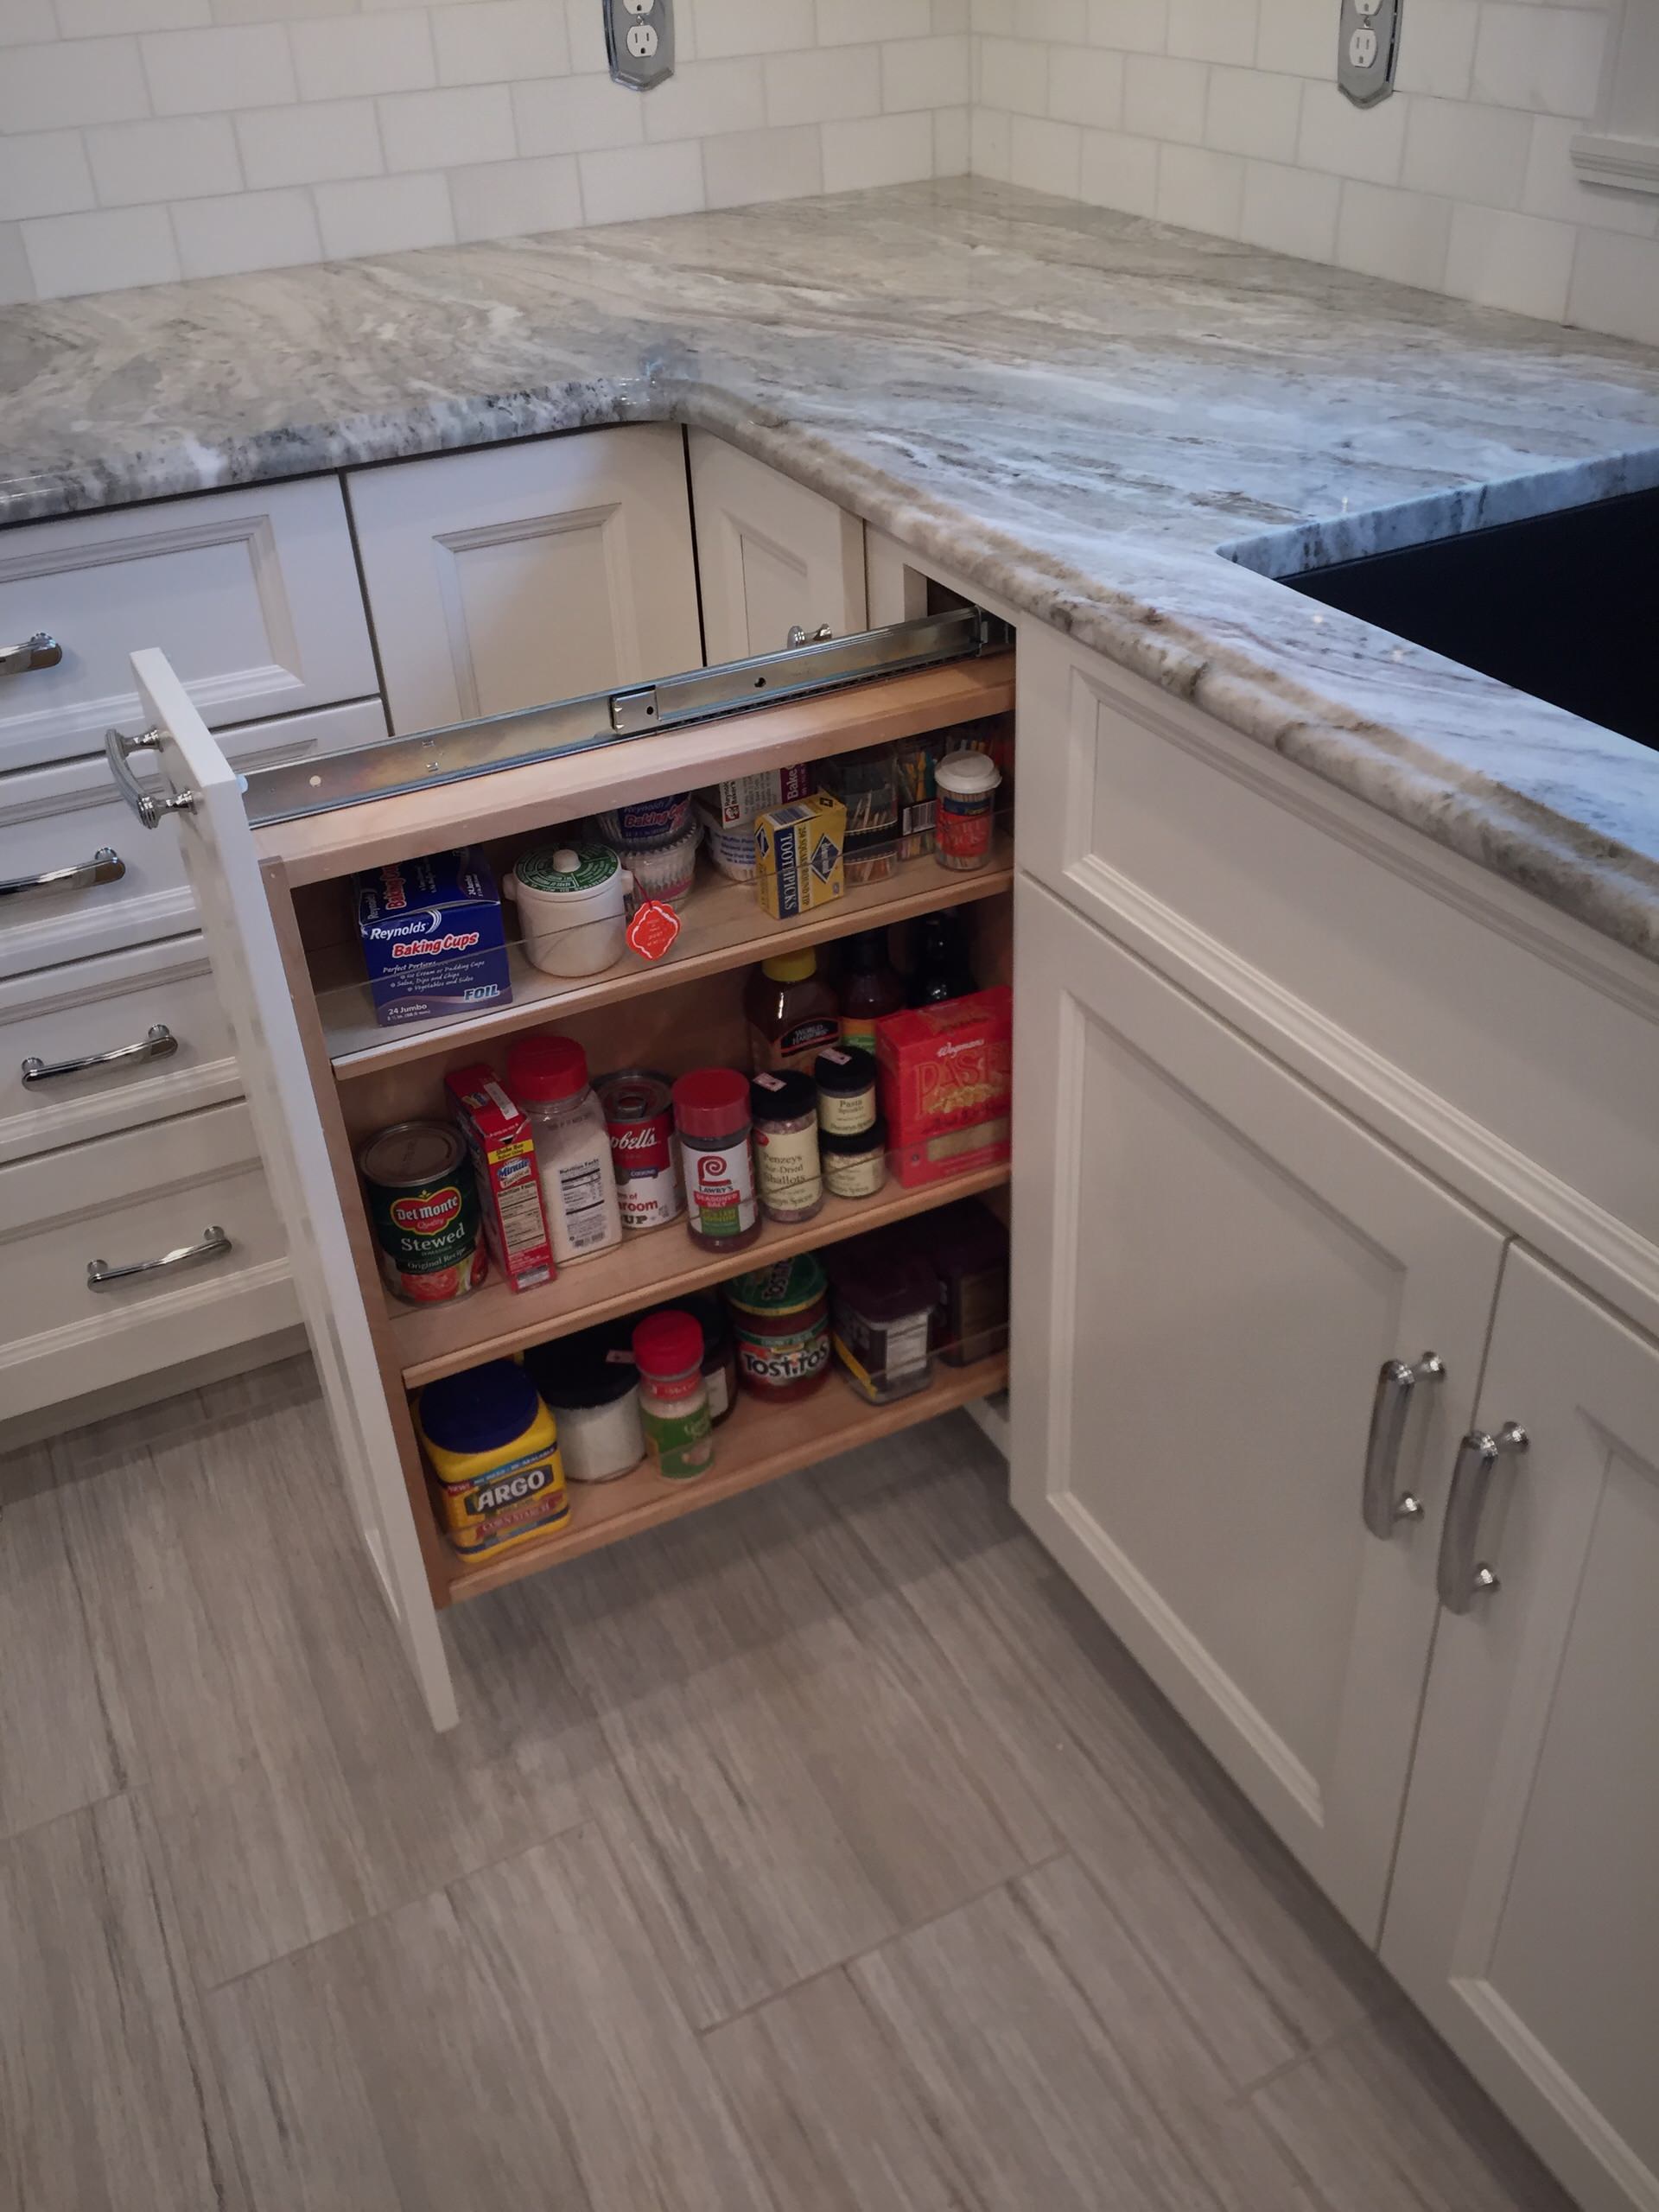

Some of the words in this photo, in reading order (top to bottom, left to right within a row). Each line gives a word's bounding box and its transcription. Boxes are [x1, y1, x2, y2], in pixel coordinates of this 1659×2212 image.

[625, 810, 670, 828] Baking
[779, 832, 796, 910] TOOTHPICKS
[385, 878, 407, 909] Baking
[370, 921, 427, 941] Reynolds
[392, 938, 442, 958] Baking
[442, 931, 480, 950] Cups
[383, 963, 407, 975] Perfect
[416, 969, 435, 977] Cream
[444, 963, 469, 973] Pudding
[470, 960, 485, 969] Cups
[416, 976, 429, 985] Dips
[443, 972, 460, 981] Chips
[414, 982, 444, 993] Vegetables
[464, 983, 500, 1003] FOIL
[400, 1003, 427, 1014] Jumbo
[839, 1099, 862, 1108] Pasta
[763, 1151, 802, 1164] Penzeys
[498, 1160, 531, 1178] Minute
[560, 1164, 584, 1175] Nutrition
[585, 1158, 600, 1166] Facts
[696, 1192, 738, 1202] SEASONED
[396, 1208, 419, 1221] Del
[420, 1195, 459, 1219] Monte
[400, 1222, 466, 1252] Stewed
[407, 1257, 442, 1269] Original
[476, 1470, 545, 1513] ARGO
